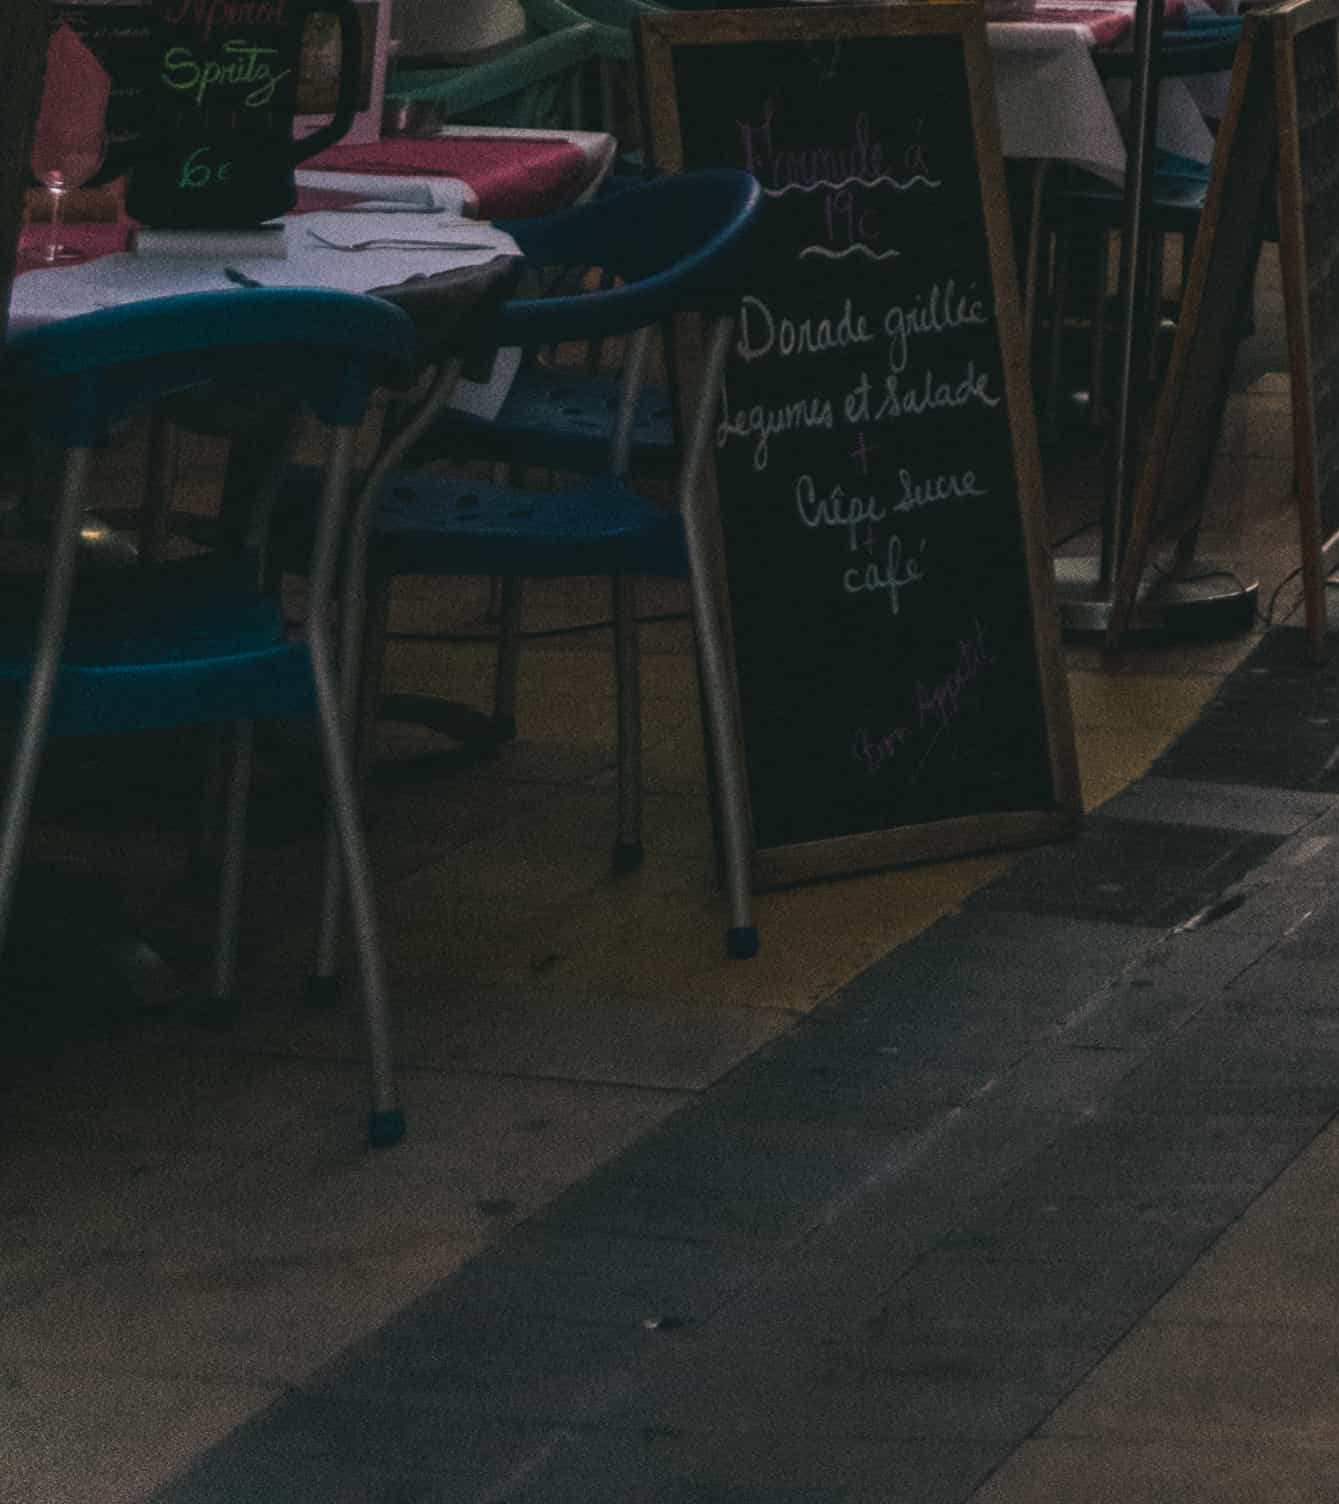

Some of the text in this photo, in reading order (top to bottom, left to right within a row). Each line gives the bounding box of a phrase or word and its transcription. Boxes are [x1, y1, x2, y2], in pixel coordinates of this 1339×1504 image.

[160, 38, 292, 108] Spritz
[736, 294, 875, 362] Dorade
[844, 372, 874, 424] et
[843, 535, 927, 615] café
